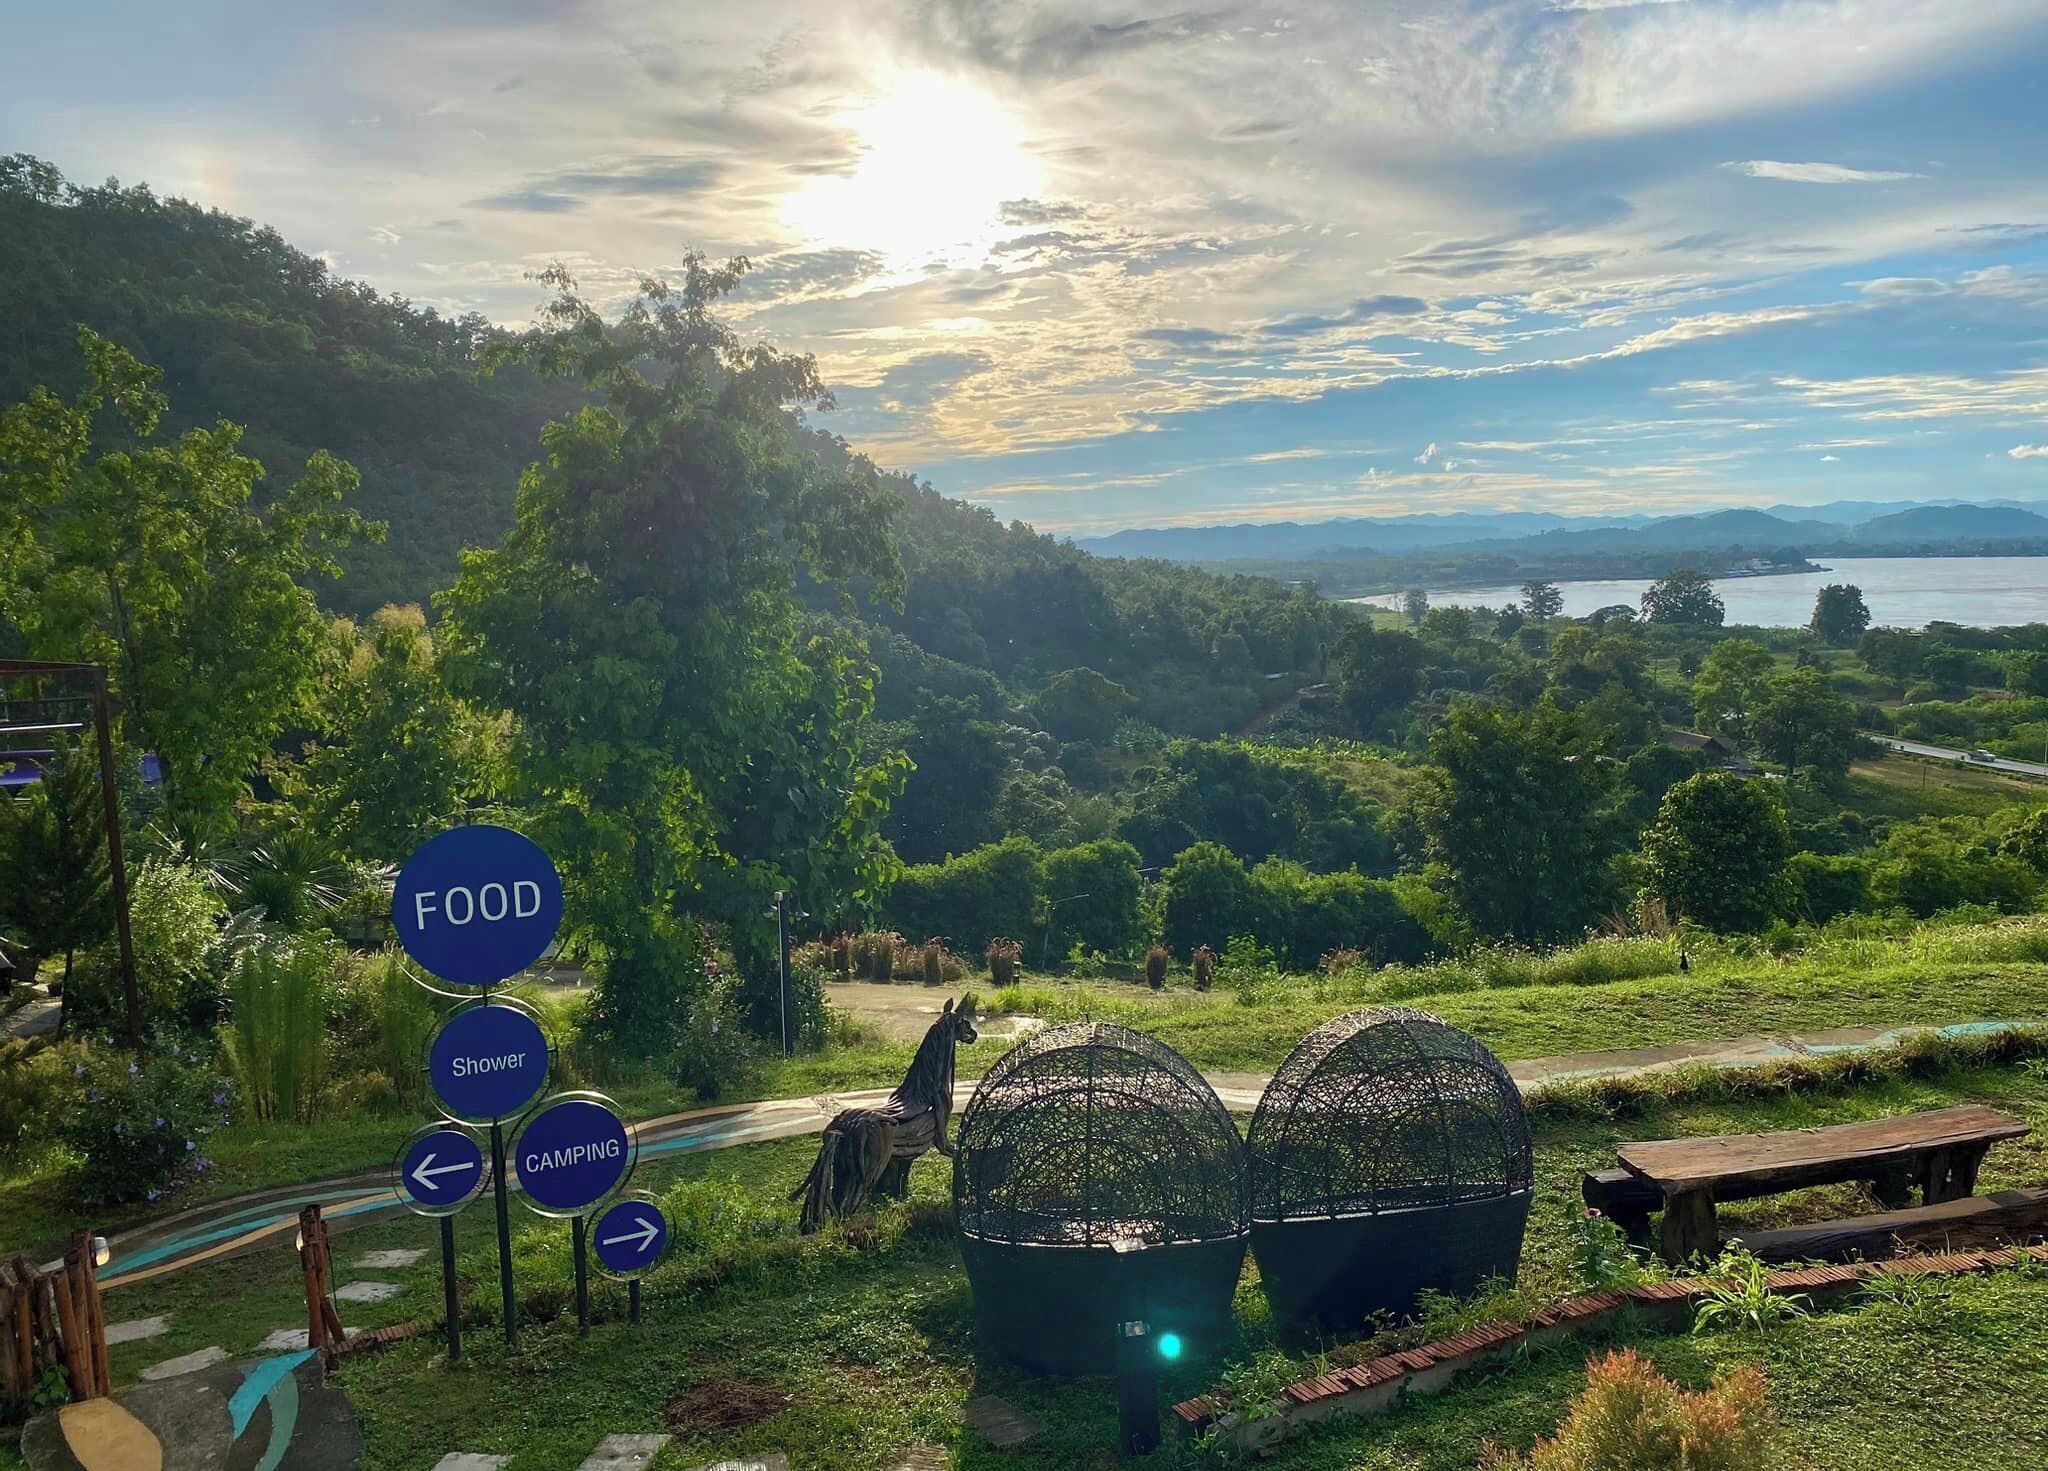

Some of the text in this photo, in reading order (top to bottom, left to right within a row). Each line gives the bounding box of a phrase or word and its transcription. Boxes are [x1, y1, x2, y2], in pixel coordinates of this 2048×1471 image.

[415, 880, 541, 930] FOOD
[452, 1052, 527, 1077] Shower
[526, 1139, 619, 1173] CAMPING
